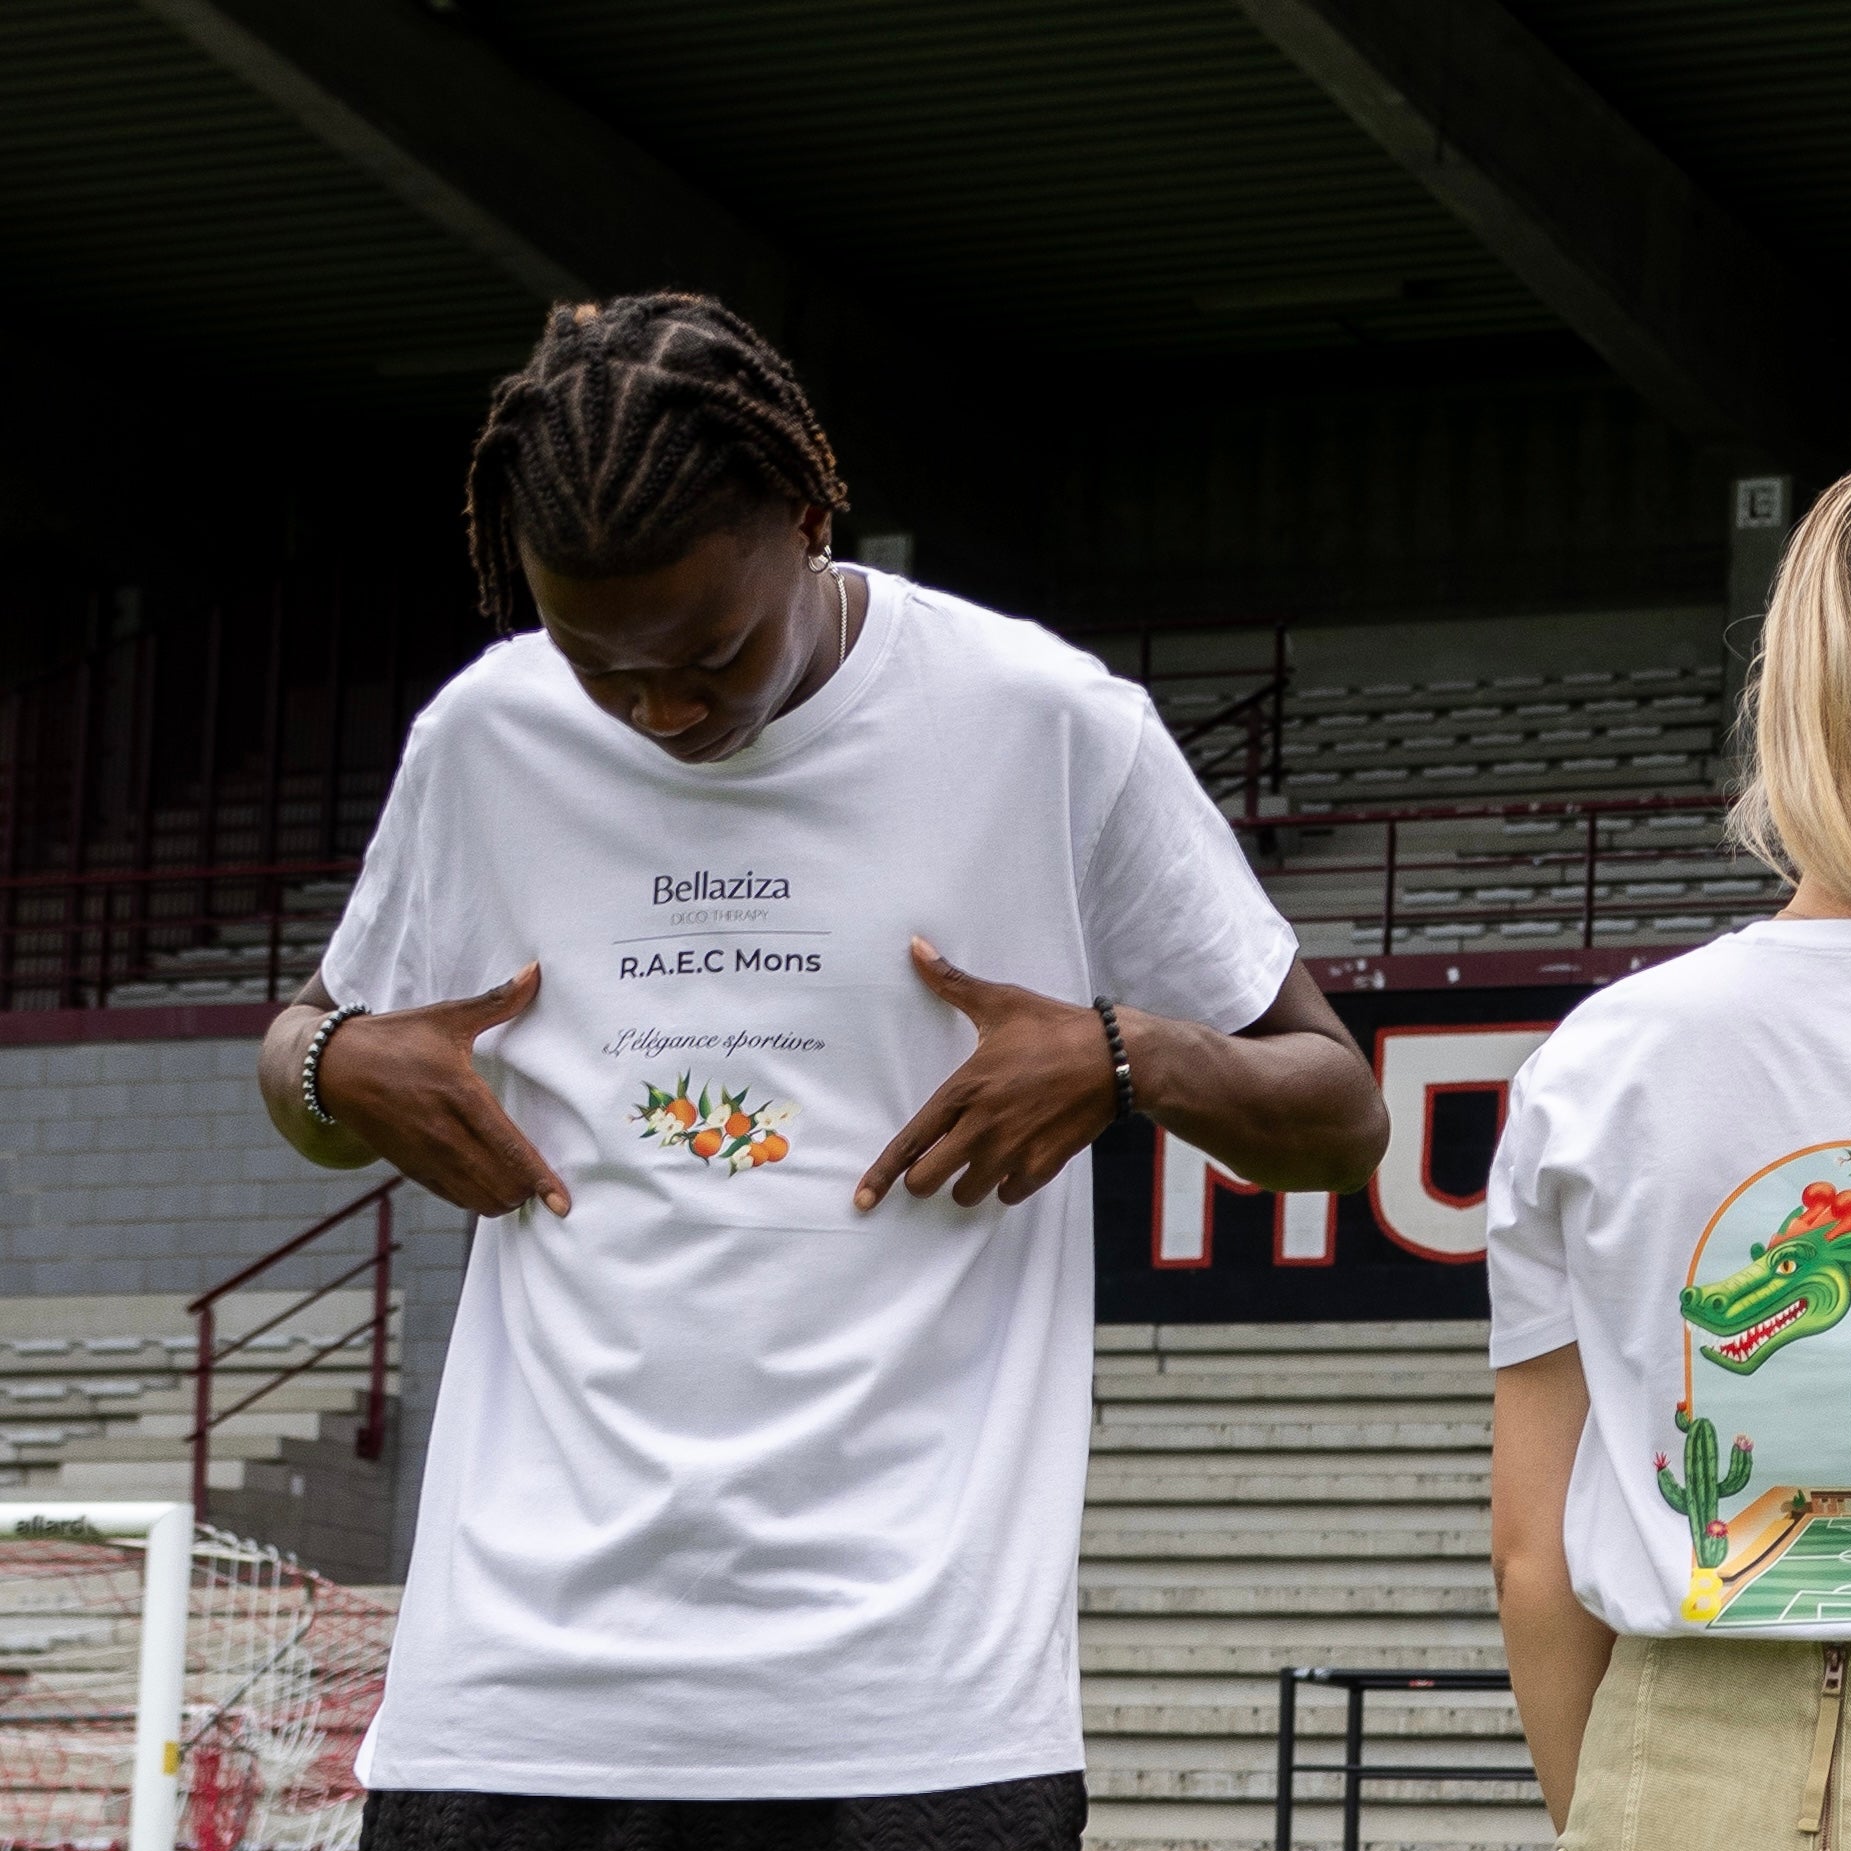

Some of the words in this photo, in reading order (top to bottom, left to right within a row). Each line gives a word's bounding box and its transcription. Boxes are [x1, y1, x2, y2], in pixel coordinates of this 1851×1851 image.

[653, 870, 791, 905] Bellaziza
[713, 908, 769, 922] THERAPY
[619, 949, 725, 980] R.A.E.C
[735, 948, 822, 973] Mons
